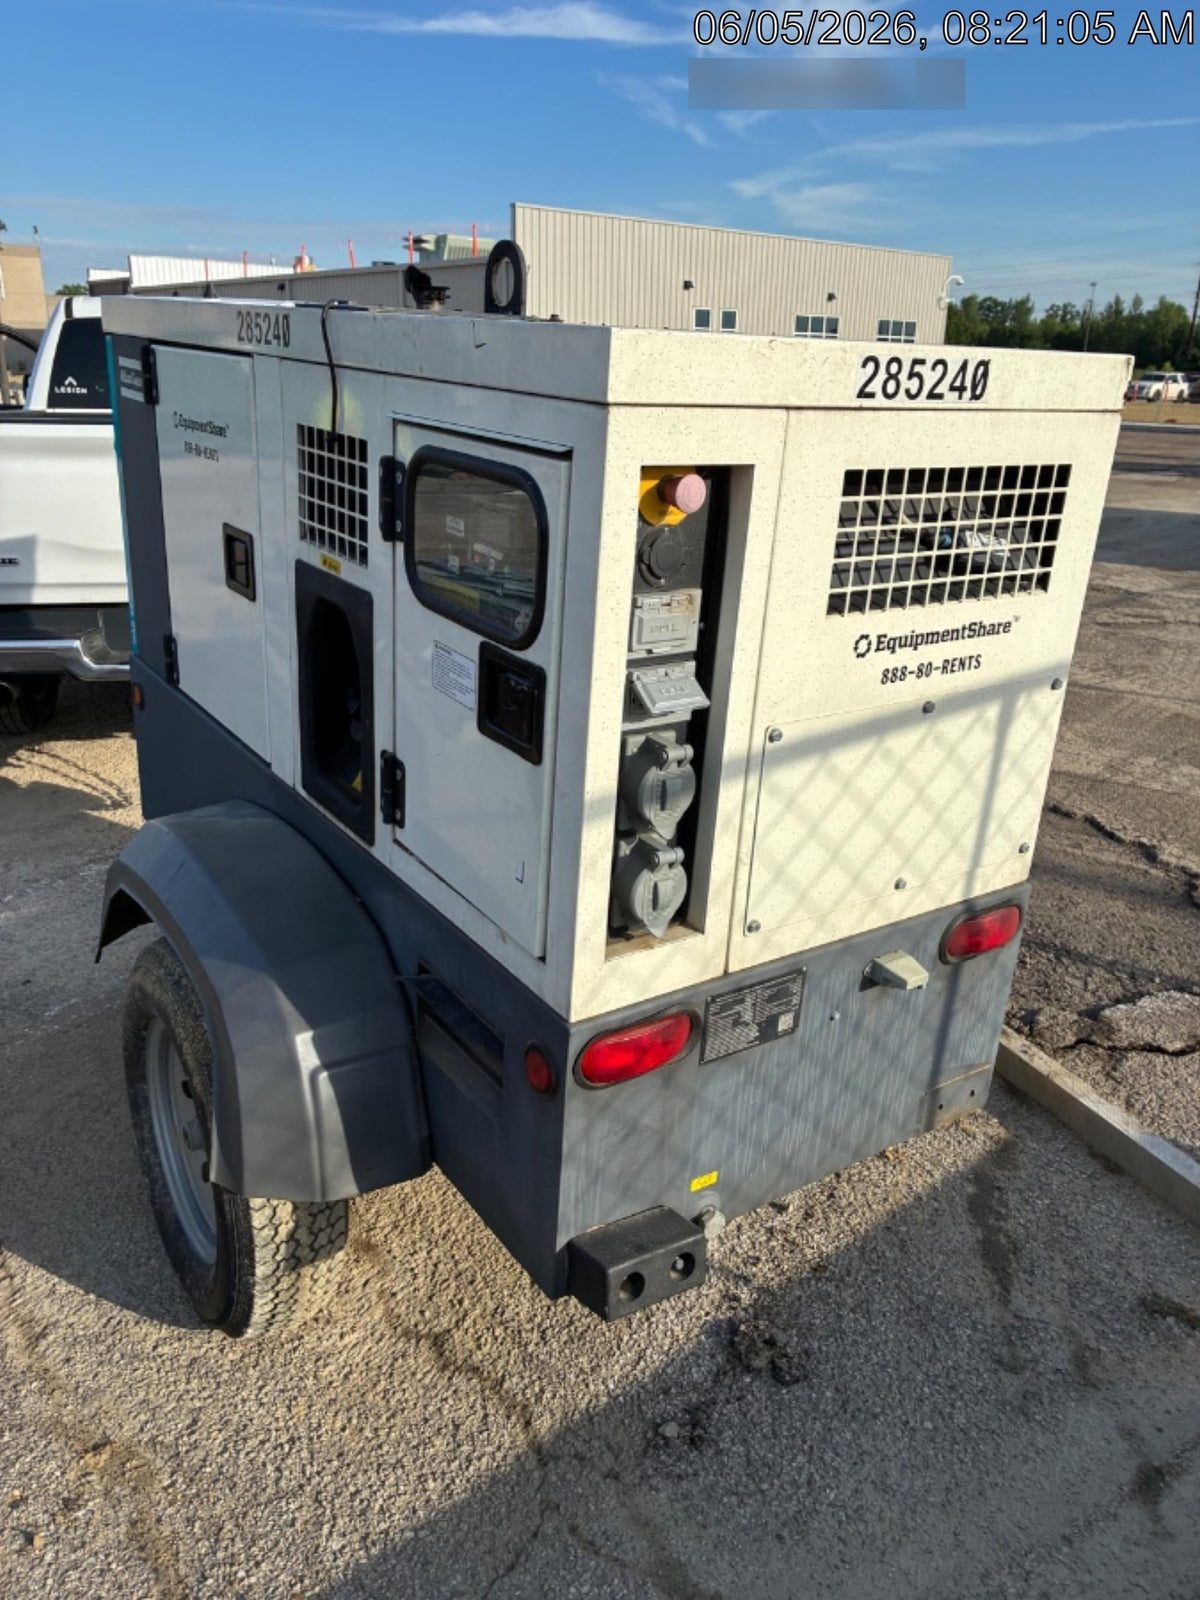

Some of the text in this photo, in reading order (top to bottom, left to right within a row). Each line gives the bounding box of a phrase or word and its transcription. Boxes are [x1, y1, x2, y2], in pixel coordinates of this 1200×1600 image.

[236, 309, 291, 349] 285240
[856, 354, 992, 403] 285240
[874, 619, 1013, 655] EquipmentShare
[880, 653, 982, 686] 888-80-RENTS
